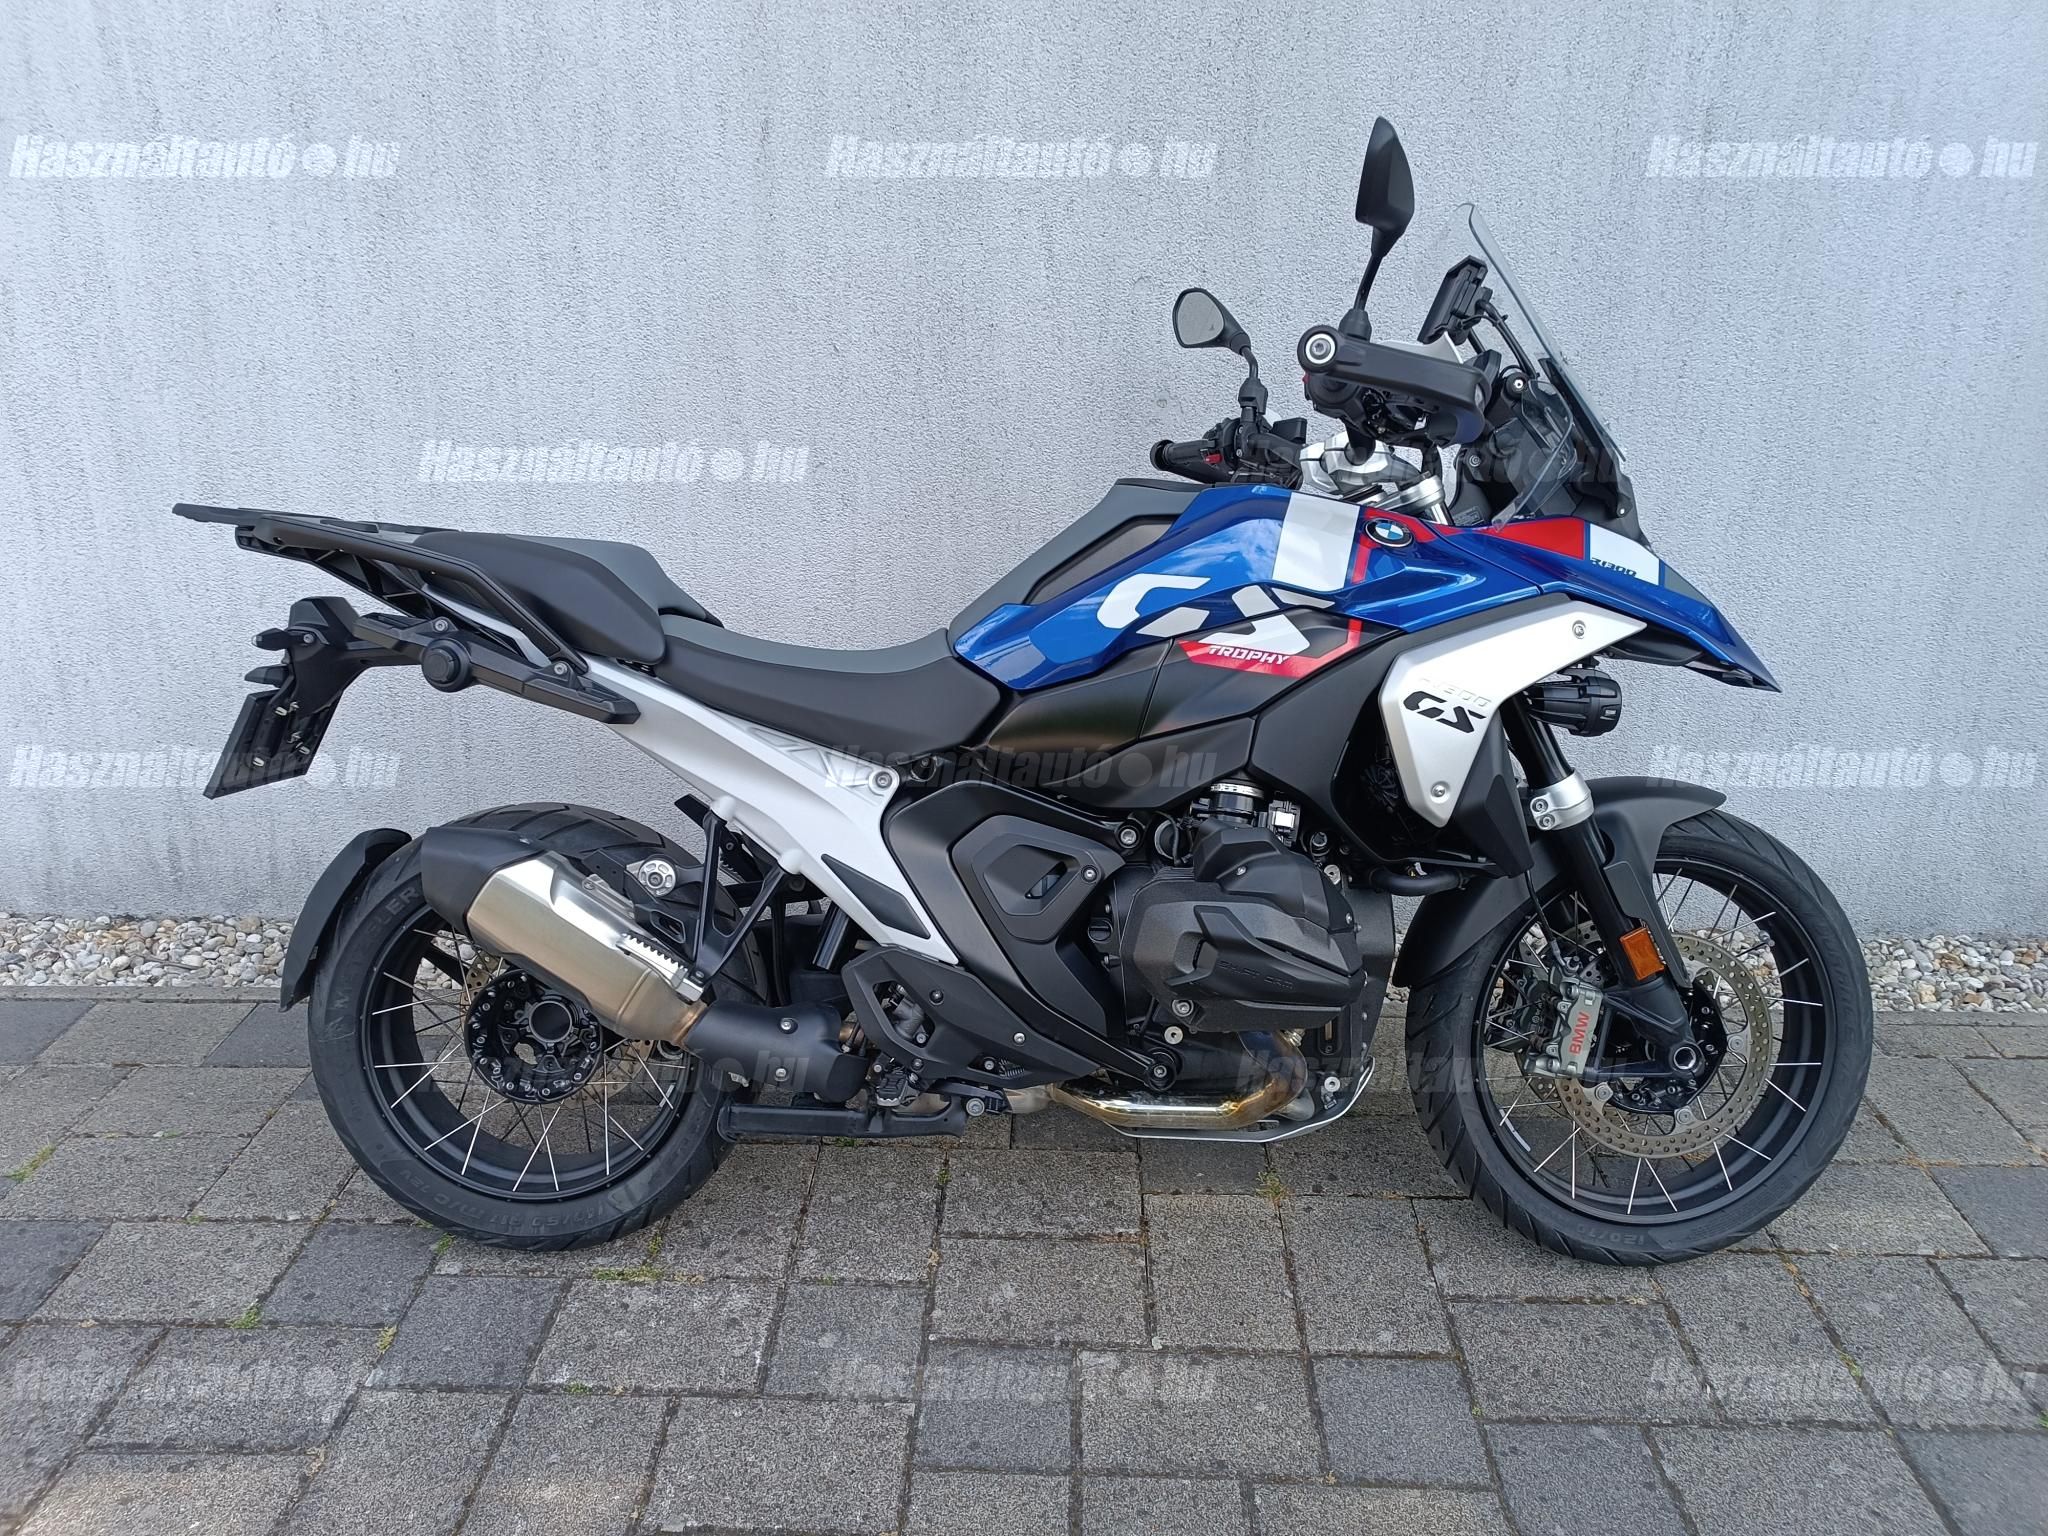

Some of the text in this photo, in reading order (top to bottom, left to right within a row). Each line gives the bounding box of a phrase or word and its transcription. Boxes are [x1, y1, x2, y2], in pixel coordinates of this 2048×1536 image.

[1207, 645, 1290, 665] TROPHY
[1403, 690, 1487, 733] GS
[1568, 1011, 1590, 1056] BMW
